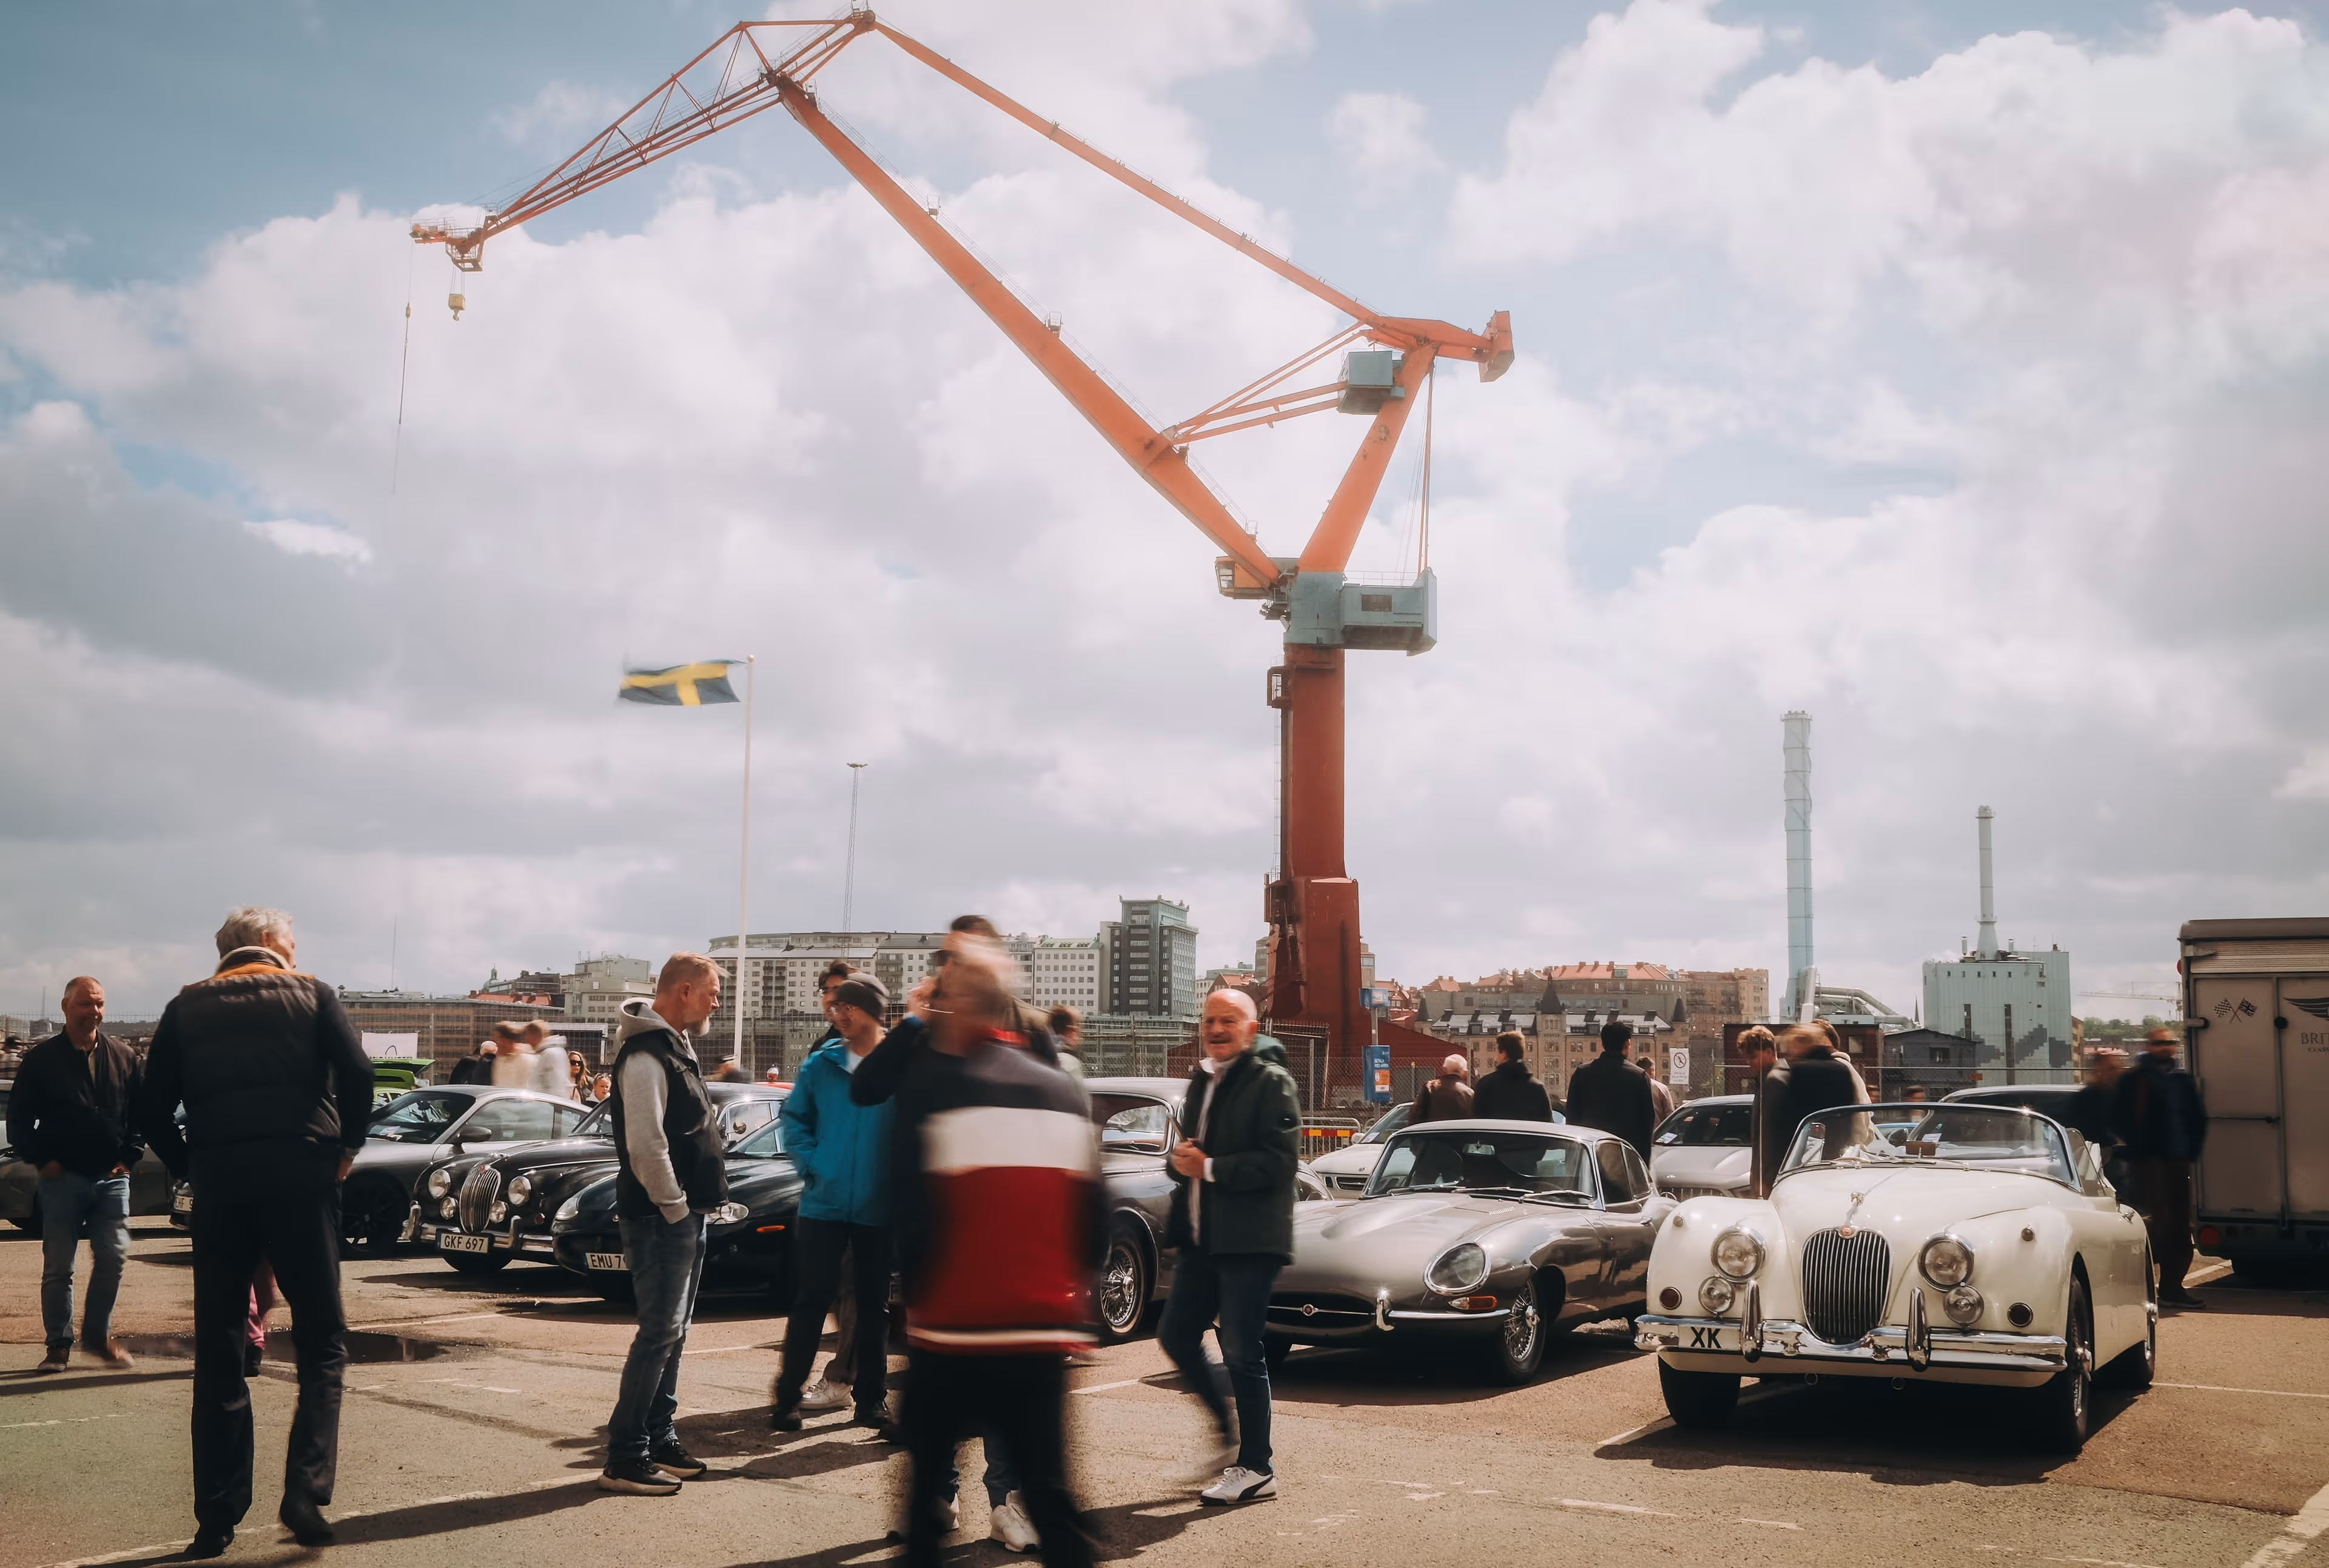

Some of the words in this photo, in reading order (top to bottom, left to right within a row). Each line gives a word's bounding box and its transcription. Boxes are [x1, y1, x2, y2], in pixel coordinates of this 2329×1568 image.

[445, 1235, 463, 1248] GKF
[466, 1237, 484, 1251] 697
[590, 1254, 613, 1268] EMU
[1690, 1326, 1722, 1349] XK
